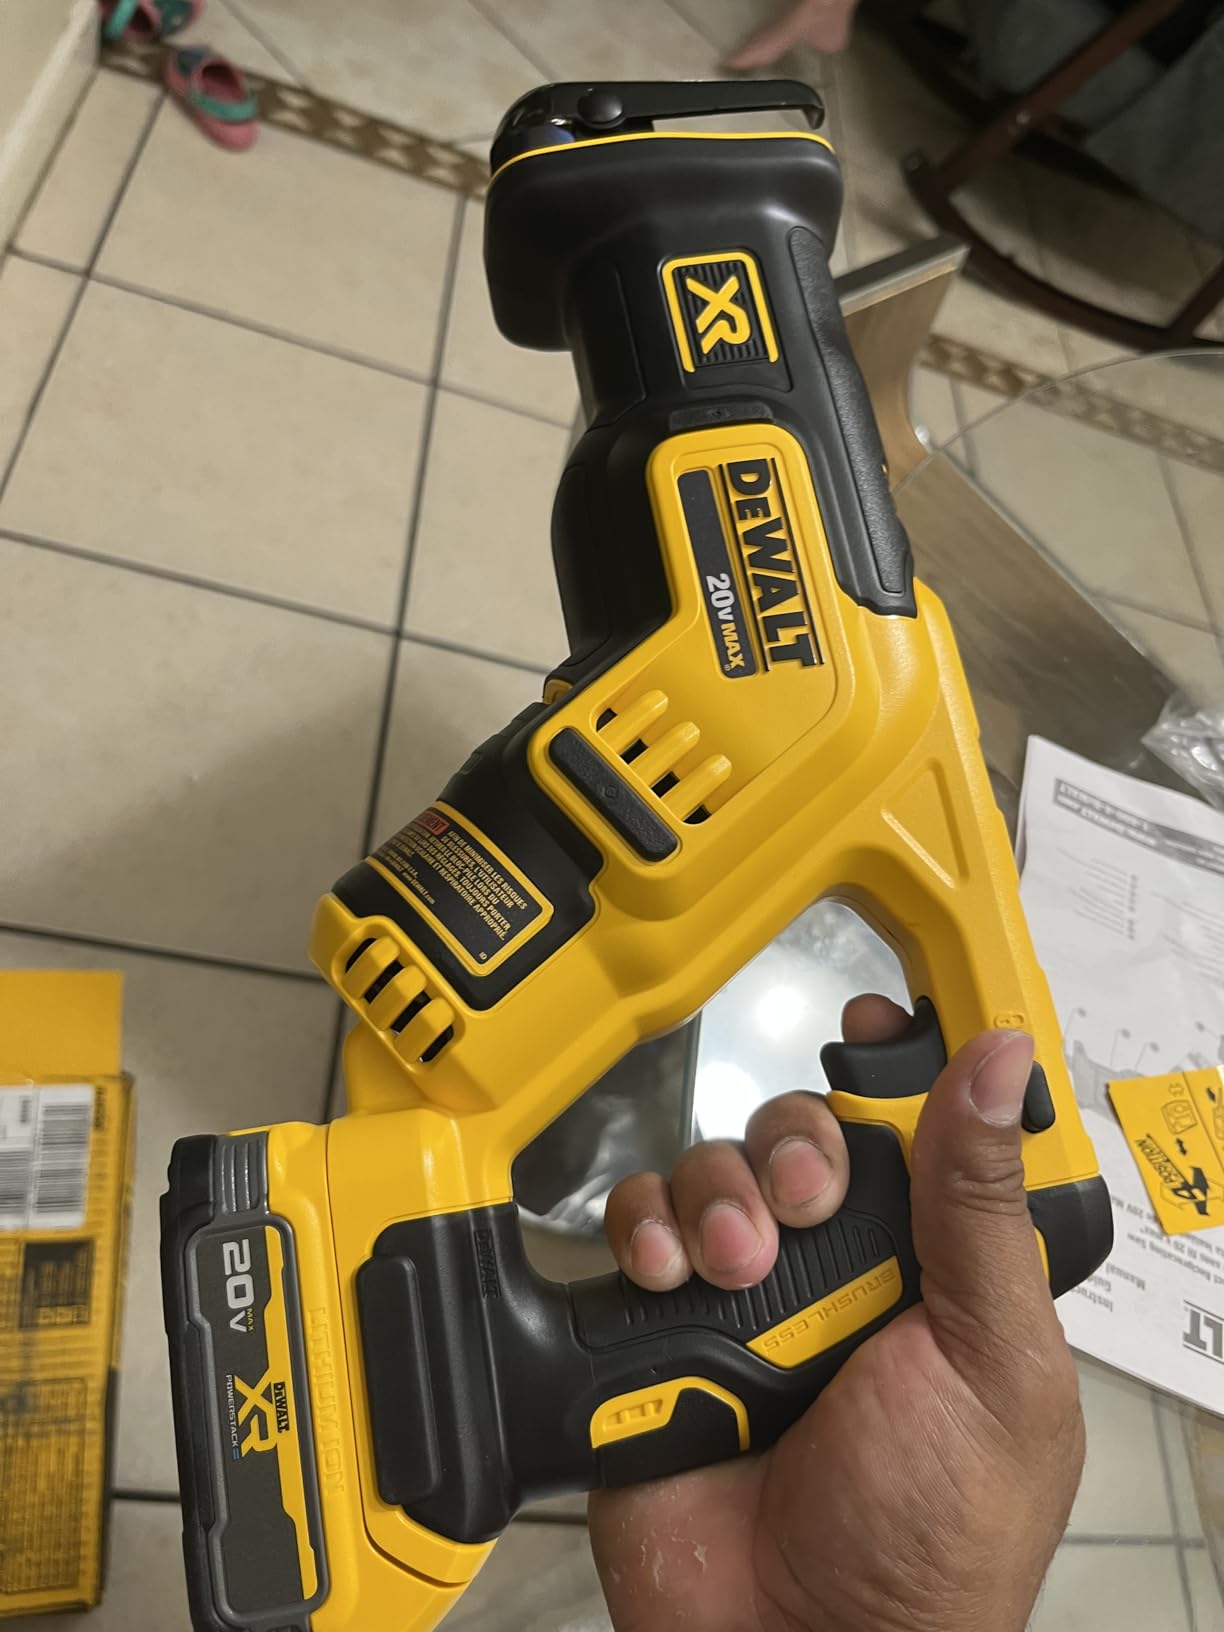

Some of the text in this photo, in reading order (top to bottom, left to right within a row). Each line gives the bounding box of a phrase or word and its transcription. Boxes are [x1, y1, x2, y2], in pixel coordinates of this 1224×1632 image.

[686, 276, 751, 354] XR
[727, 458, 816, 667] DEWALT
[439, 867, 477, 906] RESPIRATOIRE
[473, 902, 507, 941] APPROPRIÉ.
[444, 848, 453, 858] LE
[474, 878, 490, 896] LORS
[488, 894, 500, 905] DU
[457, 838, 467, 848] DE
[464, 843, 495, 875] MINIMISER
[491, 871, 505, 885] LES
[501, 881, 528, 910] RISQUES
[459, 874, 492, 908] TOUJOURS
[487, 905, 511, 931] PORTER
[474, 866, 515, 909] L'UTILISATEUR
[222, 1239, 254, 1333] 20V MAX
[763, 1267, 896, 1352] BRUSHLESS
[1106, 1263, 1146, 1290] Manual
[225, 1374, 239, 1448] POWERSTACK
[234, 1369, 277, 1457] XR
[308, 1306, 345, 1496] LITHIUM ION
